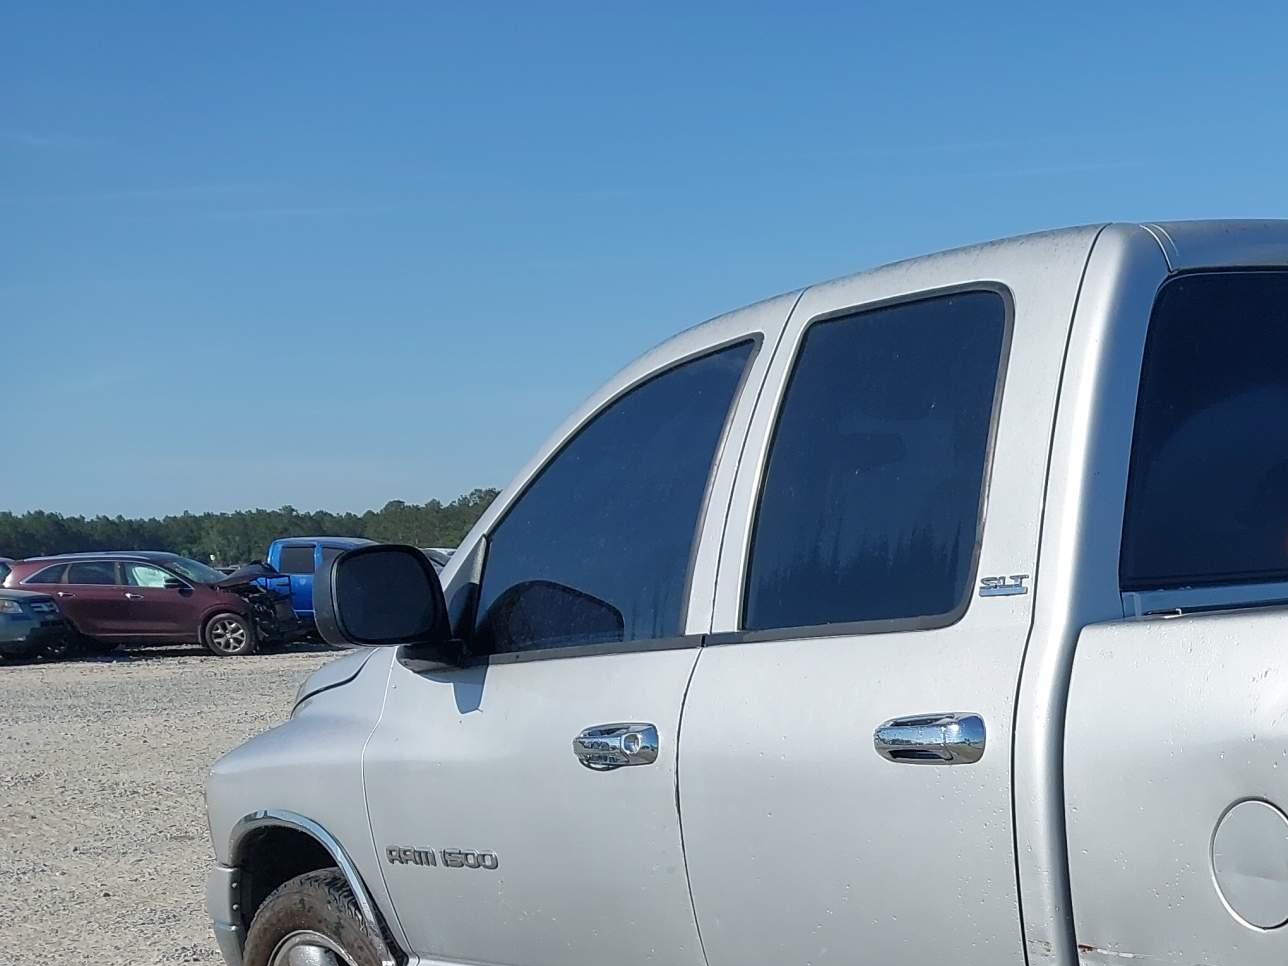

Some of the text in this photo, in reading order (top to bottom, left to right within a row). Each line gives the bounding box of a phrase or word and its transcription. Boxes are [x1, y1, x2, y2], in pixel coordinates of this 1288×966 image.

[980, 574, 1029, 589] SLT
[386, 845, 499, 871] RAM 1500
